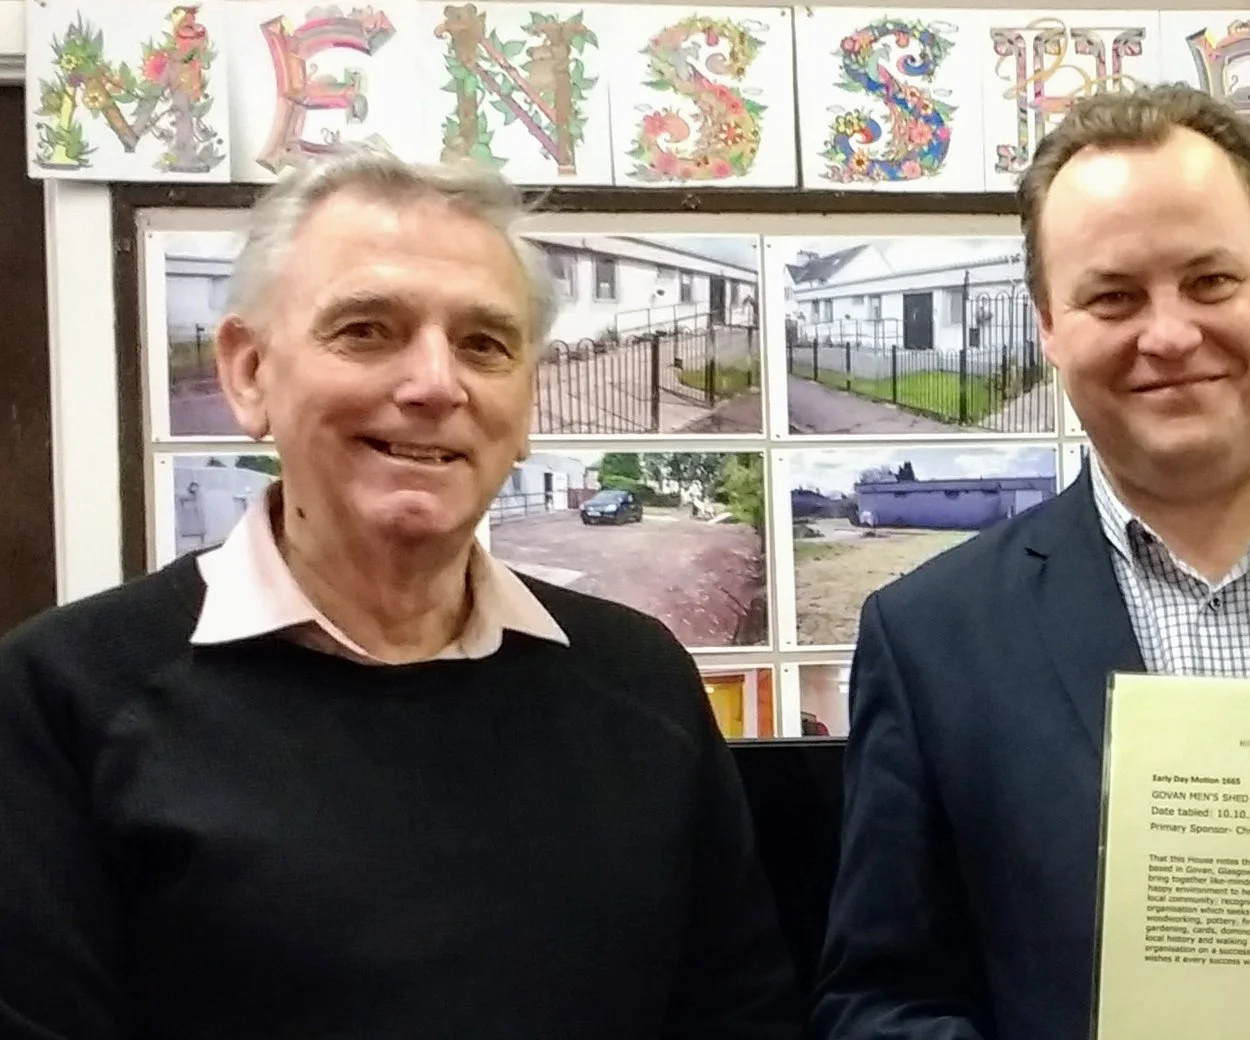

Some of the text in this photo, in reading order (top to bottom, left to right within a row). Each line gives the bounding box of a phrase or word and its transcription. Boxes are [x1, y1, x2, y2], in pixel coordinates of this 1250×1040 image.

[1152, 773, 1240, 786] Early Day Motion 1665
[1152, 789, 1249, 803] GOVAN MEN'S SHED
[1151, 805, 1175, 816] Date
[1150, 822, 1186, 835] Primary
[1149, 853, 1168, 862] That
[1170, 854, 1186, 863] this
[1187, 855, 1214, 864] House
[1216, 856, 1239, 865] notes
[1149, 863, 1174, 872] based
[1148, 873, 1170, 884] bring
[1172, 874, 1207, 886] together
[1148, 883, 1173, 894] happy
[1175, 885, 1229, 895] environment
[1148, 893, 1166, 902] local
[1147, 903, 1198, 915] organisation
[1200, 906, 1224, 915] which
[1226, 907, 1250, 916] seeks
[1145, 933, 1165, 942] local
[1166, 934, 1195, 945] history
[1198, 936, 1214, 944] and
[1216, 936, 1248, 947] walking
[1145, 943, 1196, 955] organisation
[1144, 953, 1172, 962] wishes
[1182, 956, 1206, 966] every
